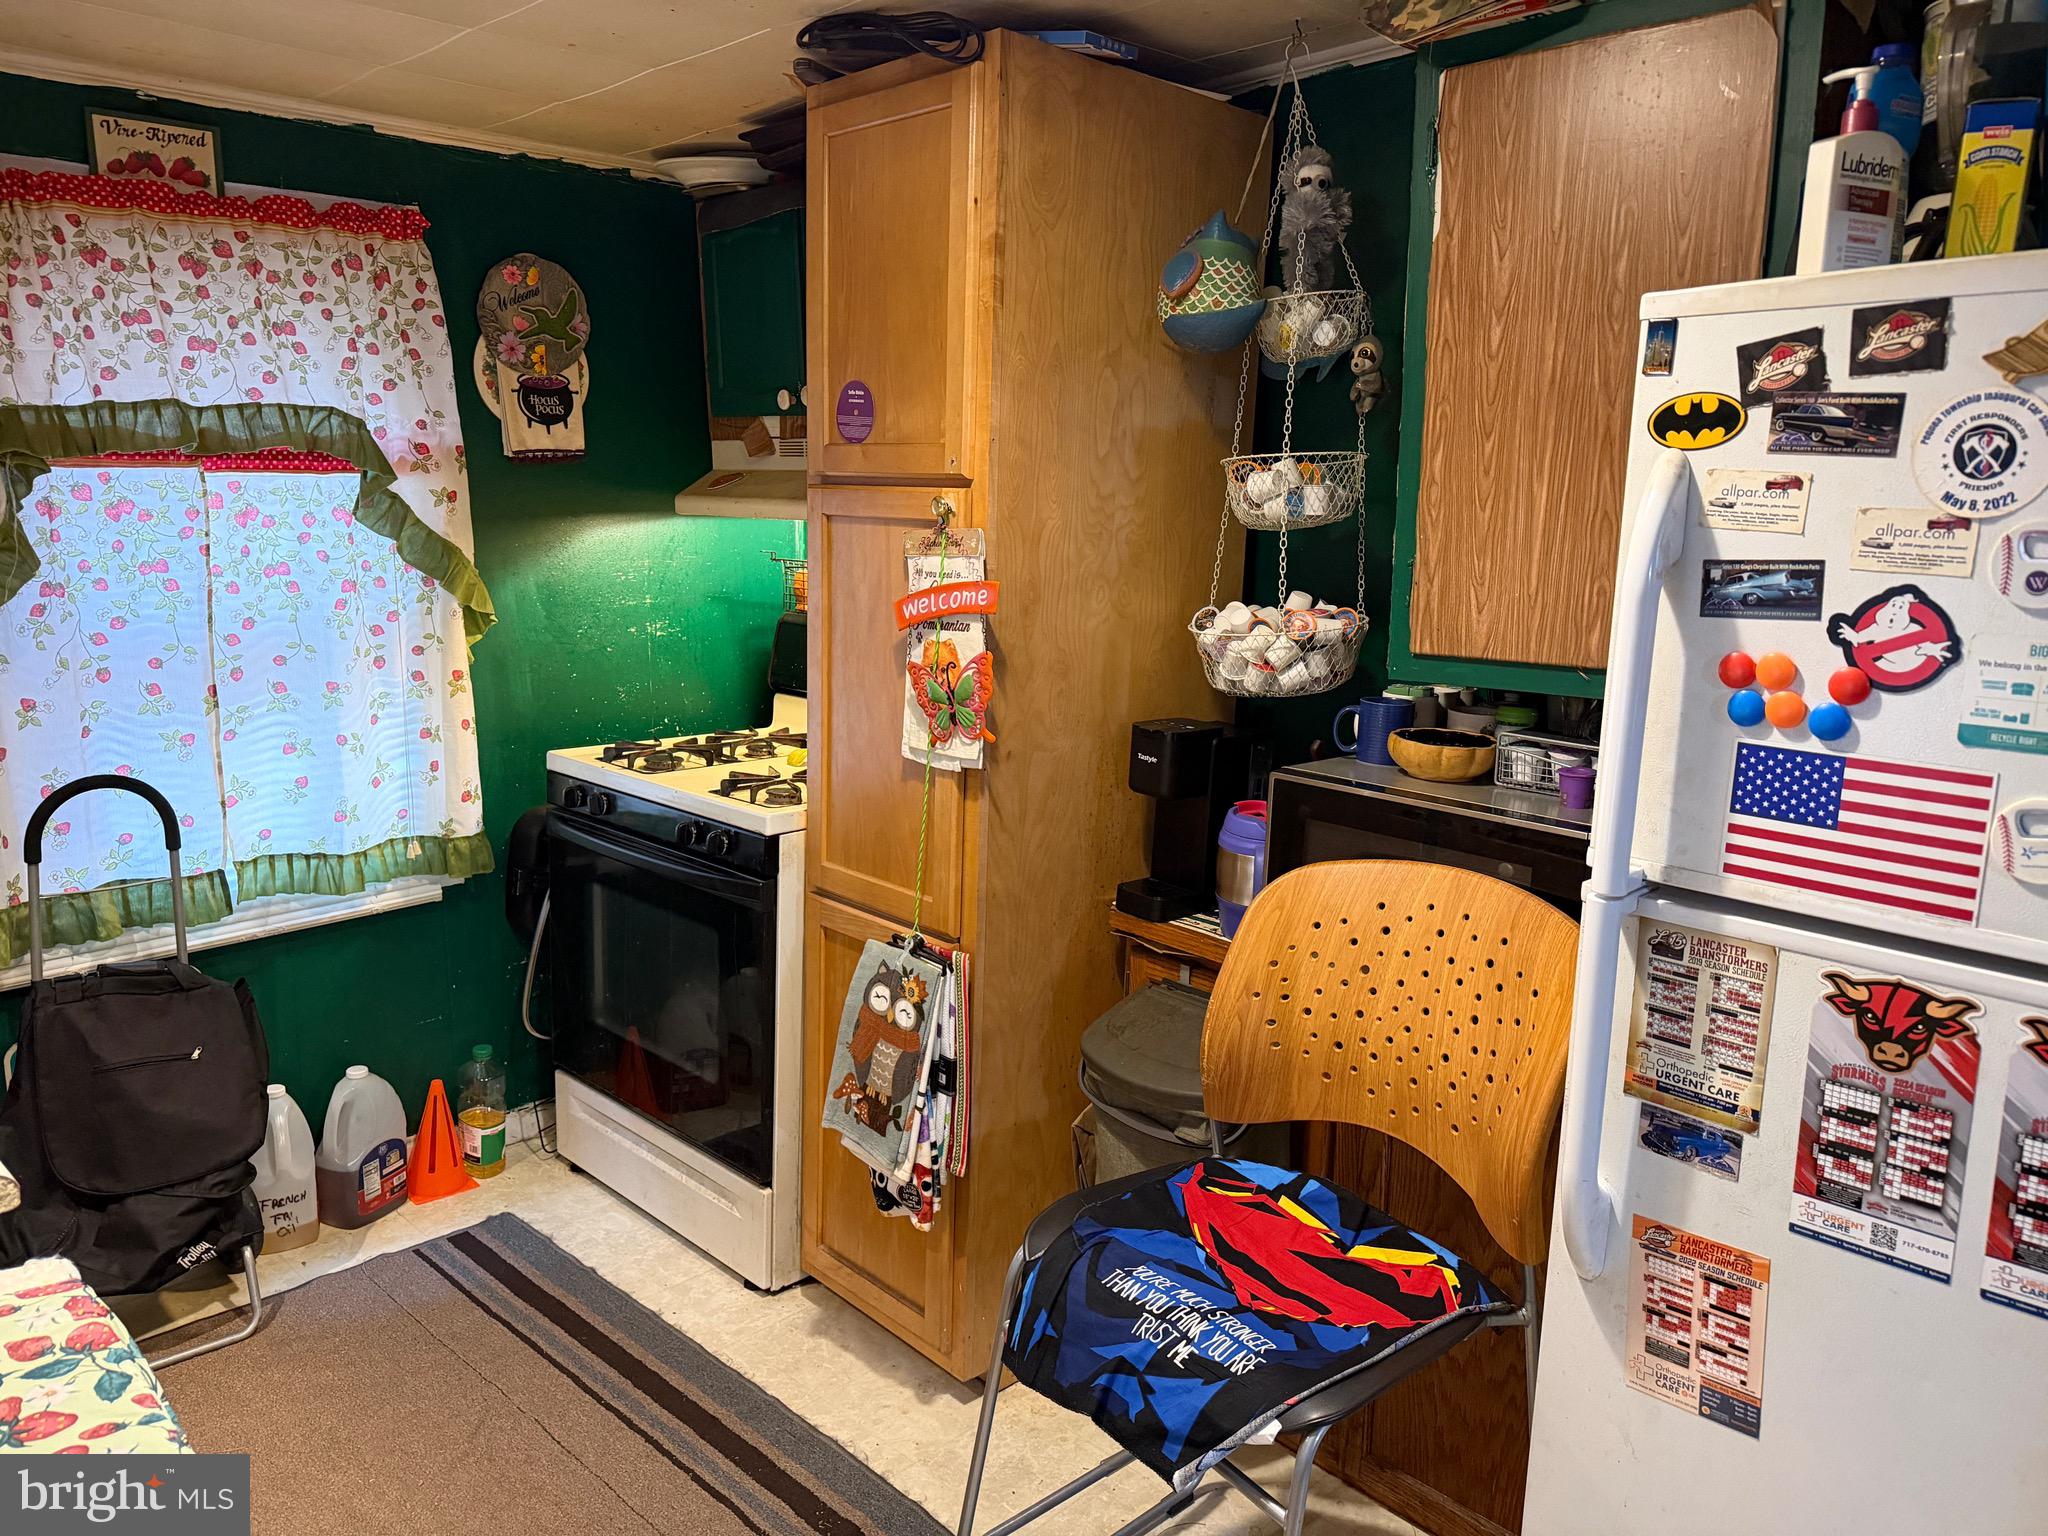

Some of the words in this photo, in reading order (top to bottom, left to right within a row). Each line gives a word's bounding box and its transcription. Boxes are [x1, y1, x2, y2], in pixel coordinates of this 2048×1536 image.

[100, 119, 207, 148] Vine-Ripened
[482, 284, 541, 312] Welcome
[1857, 319, 1939, 360] Lancaster
[1746, 347, 1817, 394] Lancaster
[1944, 419, 1968, 443] FIRST
[1969, 412, 2029, 440] RESPONDERS
[1721, 483, 1790, 500] allpar.com
[1958, 480, 2004, 492] FRIENDS
[1940, 491, 1967, 510] May
[1969, 499, 1980, 512] 8,
[1983, 492, 2018, 511] 2022
[1875, 523, 1956, 540] allpar.com
[902, 588, 988, 620] welcome
[1978, 659, 1992, 667] We
[1994, 660, 2022, 671] belong
[2023, 662, 2032, 670] in
[2034, 664, 2048, 672] the
[1138, 752, 1158, 764] Tastyle
[1689, 946, 1768, 973] BARNSTORMERS
[1690, 936, 1747, 958] LANCASTER
[1688, 956, 1702, 966] 2019
[1704, 958, 1730, 973] SEASON
[1732, 966, 1768, 982] SCHEDULE
[1656, 1058, 1714, 1084] Orthopedic
[1831, 1064, 1886, 1092] STORMERS
[1839, 1062, 1880, 1076] LANCASTER
[1656, 1068, 1706, 1091] URGENT
[1708, 1083, 1740, 1102] CARE
[259, 1190, 307, 1212] FRENCH
[1822, 1220, 1851, 1234] CARE
[1823, 1212, 1866, 1232] URGENT
[176, 1240, 215, 1269] Trolley
[1680, 1234, 1733, 1259] LANCASTER
[1678, 1255, 1696, 1268] 2022
[1698, 1261, 1726, 1278] SEASON
[1727, 1271, 1764, 1290] SCHEDULE
[1680, 1244, 1753, 1276] BARNSTORMERS
[1102, 1268, 1148, 1302] THAN
[1136, 1288, 1176, 1315] YOU
[1166, 1304, 1214, 1343] THINK
[1200, 1330, 1238, 1362] YOU
[1224, 1352, 1267, 1376] ARE
[1171, 1288, 1218, 1312] MUCH
[1207, 1310, 1277, 1355] STRONGER
[1130, 1312, 1181, 1350] TRUST
[1167, 1340, 1200, 1369] ME
[1655, 1363, 1697, 1384] Orthopedic
[1655, 1370, 1696, 1394] URGENT
[1655, 1380, 1680, 1395] CARE
